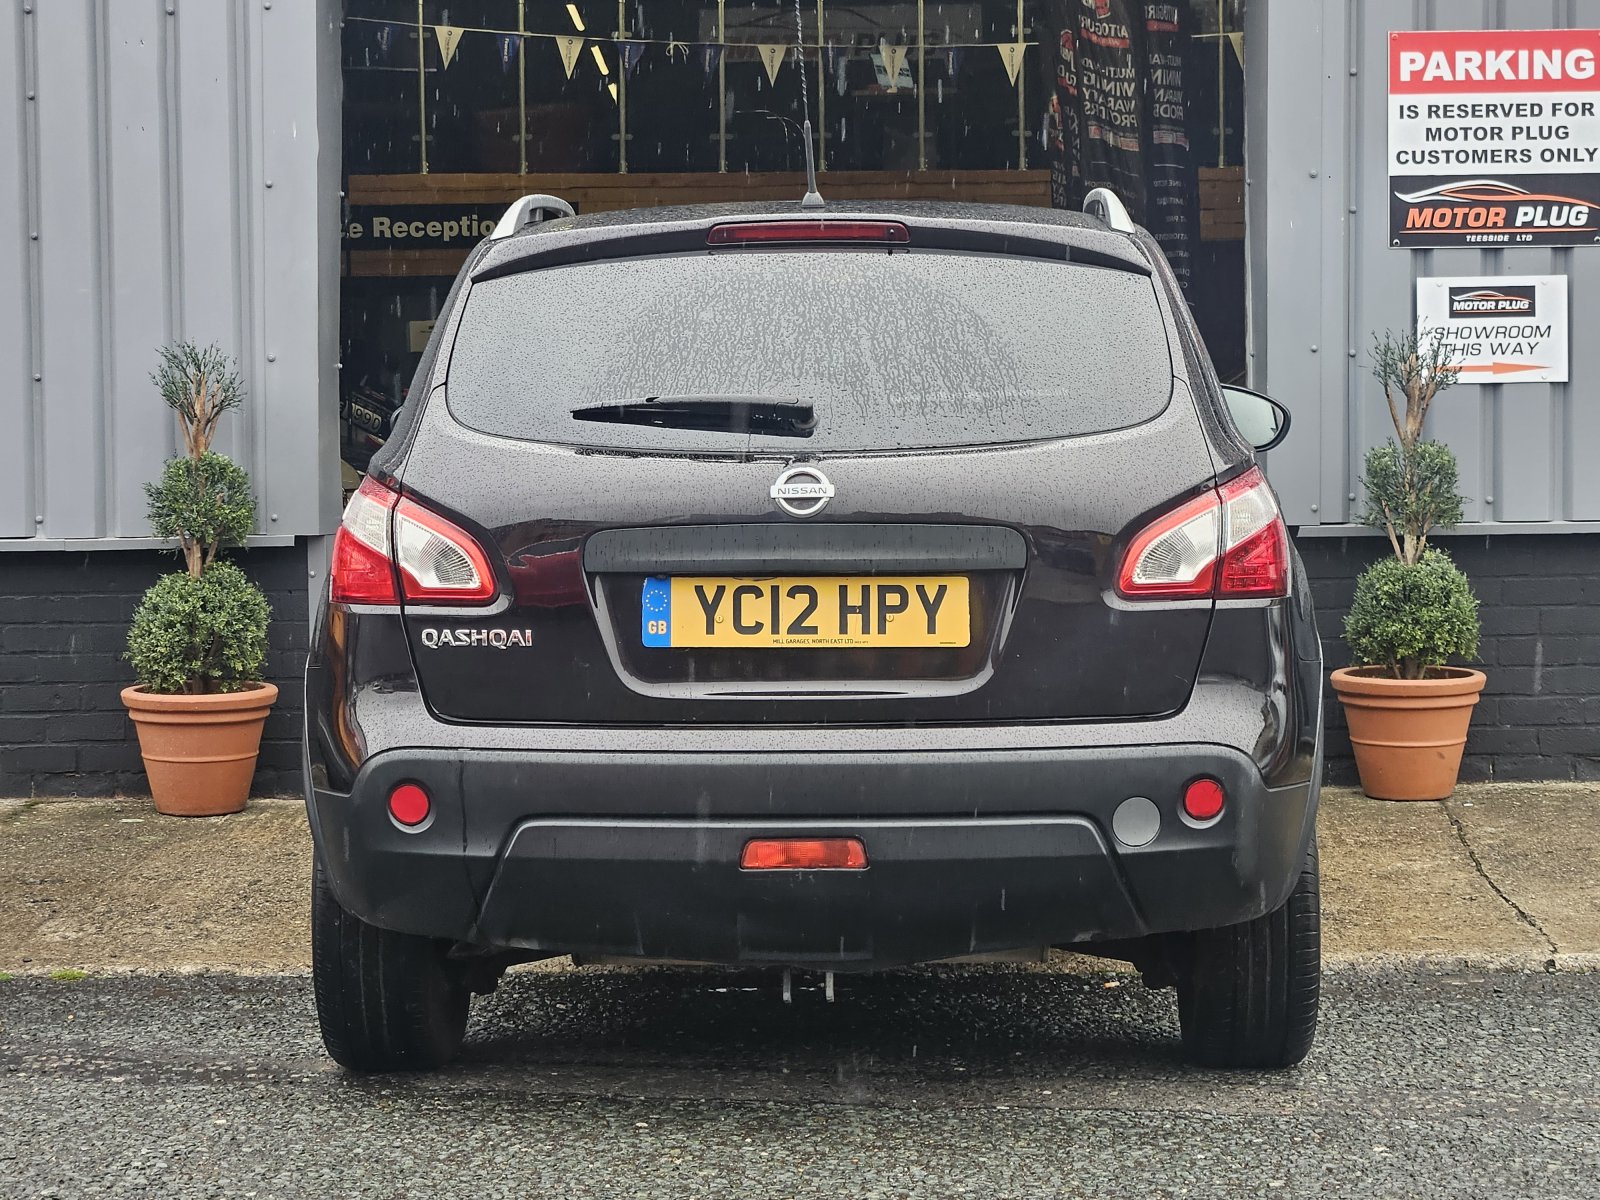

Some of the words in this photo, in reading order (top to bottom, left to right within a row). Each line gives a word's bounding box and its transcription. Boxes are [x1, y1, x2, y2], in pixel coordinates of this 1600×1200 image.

[1399, 48, 1595, 82] PARKING
[1399, 104, 1419, 120] IS
[1427, 103, 1543, 119] RESERVED
[1551, 102, 1595, 117] FOR
[1425, 126, 1504, 142] MOTOR
[1511, 125, 1570, 141] PLUG
[1396, 149, 1532, 165] CUSTOMERS
[1540, 147, 1599, 163] ONLY
[1406, 207, 1506, 228] MOTOR
[1515, 205, 1589, 227] PLUG
[372, 214, 498, 242] Receptio
[1466, 234, 1510, 242] TEESSIDE
[1516, 234, 1533, 242] LTD
[1453, 301, 1495, 310] MOTOR
[1498, 301, 1529, 310] PLUG
[1434, 325, 1552, 340] SHOWROOM
[1441, 343, 1482, 356] THIS
[1490, 342, 1540, 355] WAY
[777, 487, 828, 495] NISSAN
[694, 585, 819, 635] YC12
[838, 585, 948, 635] HPY
[647, 620, 667, 635] GB
[421, 628, 533, 650] QASHQAI
